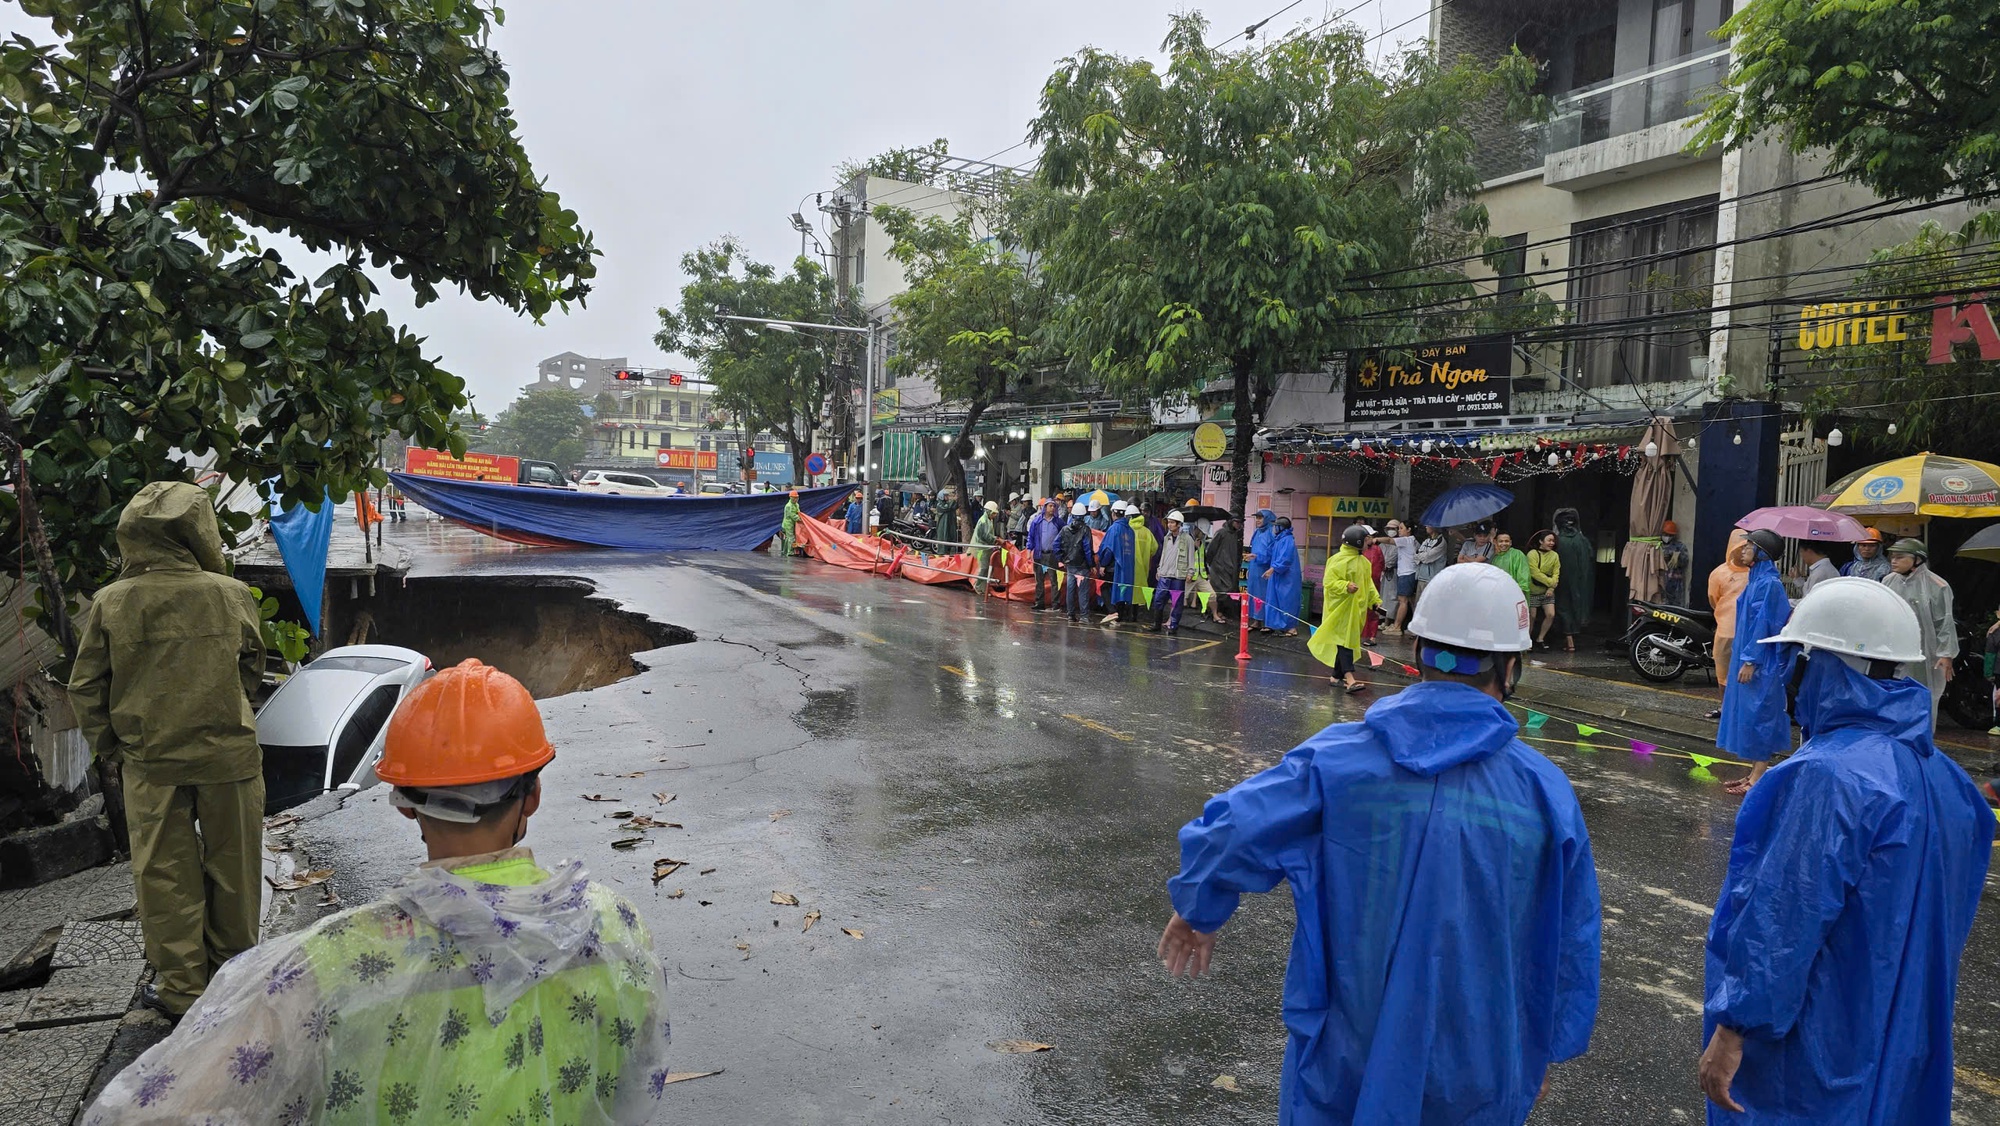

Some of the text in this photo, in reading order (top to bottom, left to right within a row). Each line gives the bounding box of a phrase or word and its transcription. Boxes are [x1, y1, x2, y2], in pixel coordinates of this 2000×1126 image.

[1799, 299, 1908, 351] COFFEE
[670, 375, 681, 385] 30
[1387, 361, 1490, 390] Trà Ngon
[1382, 397, 1394, 407] TRÀ
[1413, 395, 1426, 405] TRÀ
[1428, 394, 1444, 404] TRÁI
[1445, 393, 1459, 403] CÂY
[1466, 391, 1487, 402] NƯỚC
[1488, 390, 1498, 401] ÉP
[1388, 408, 1400, 416] Công
[1336, 497, 1390, 517] ĂN VẶT
[1652, 610, 1681, 624] DQTV
